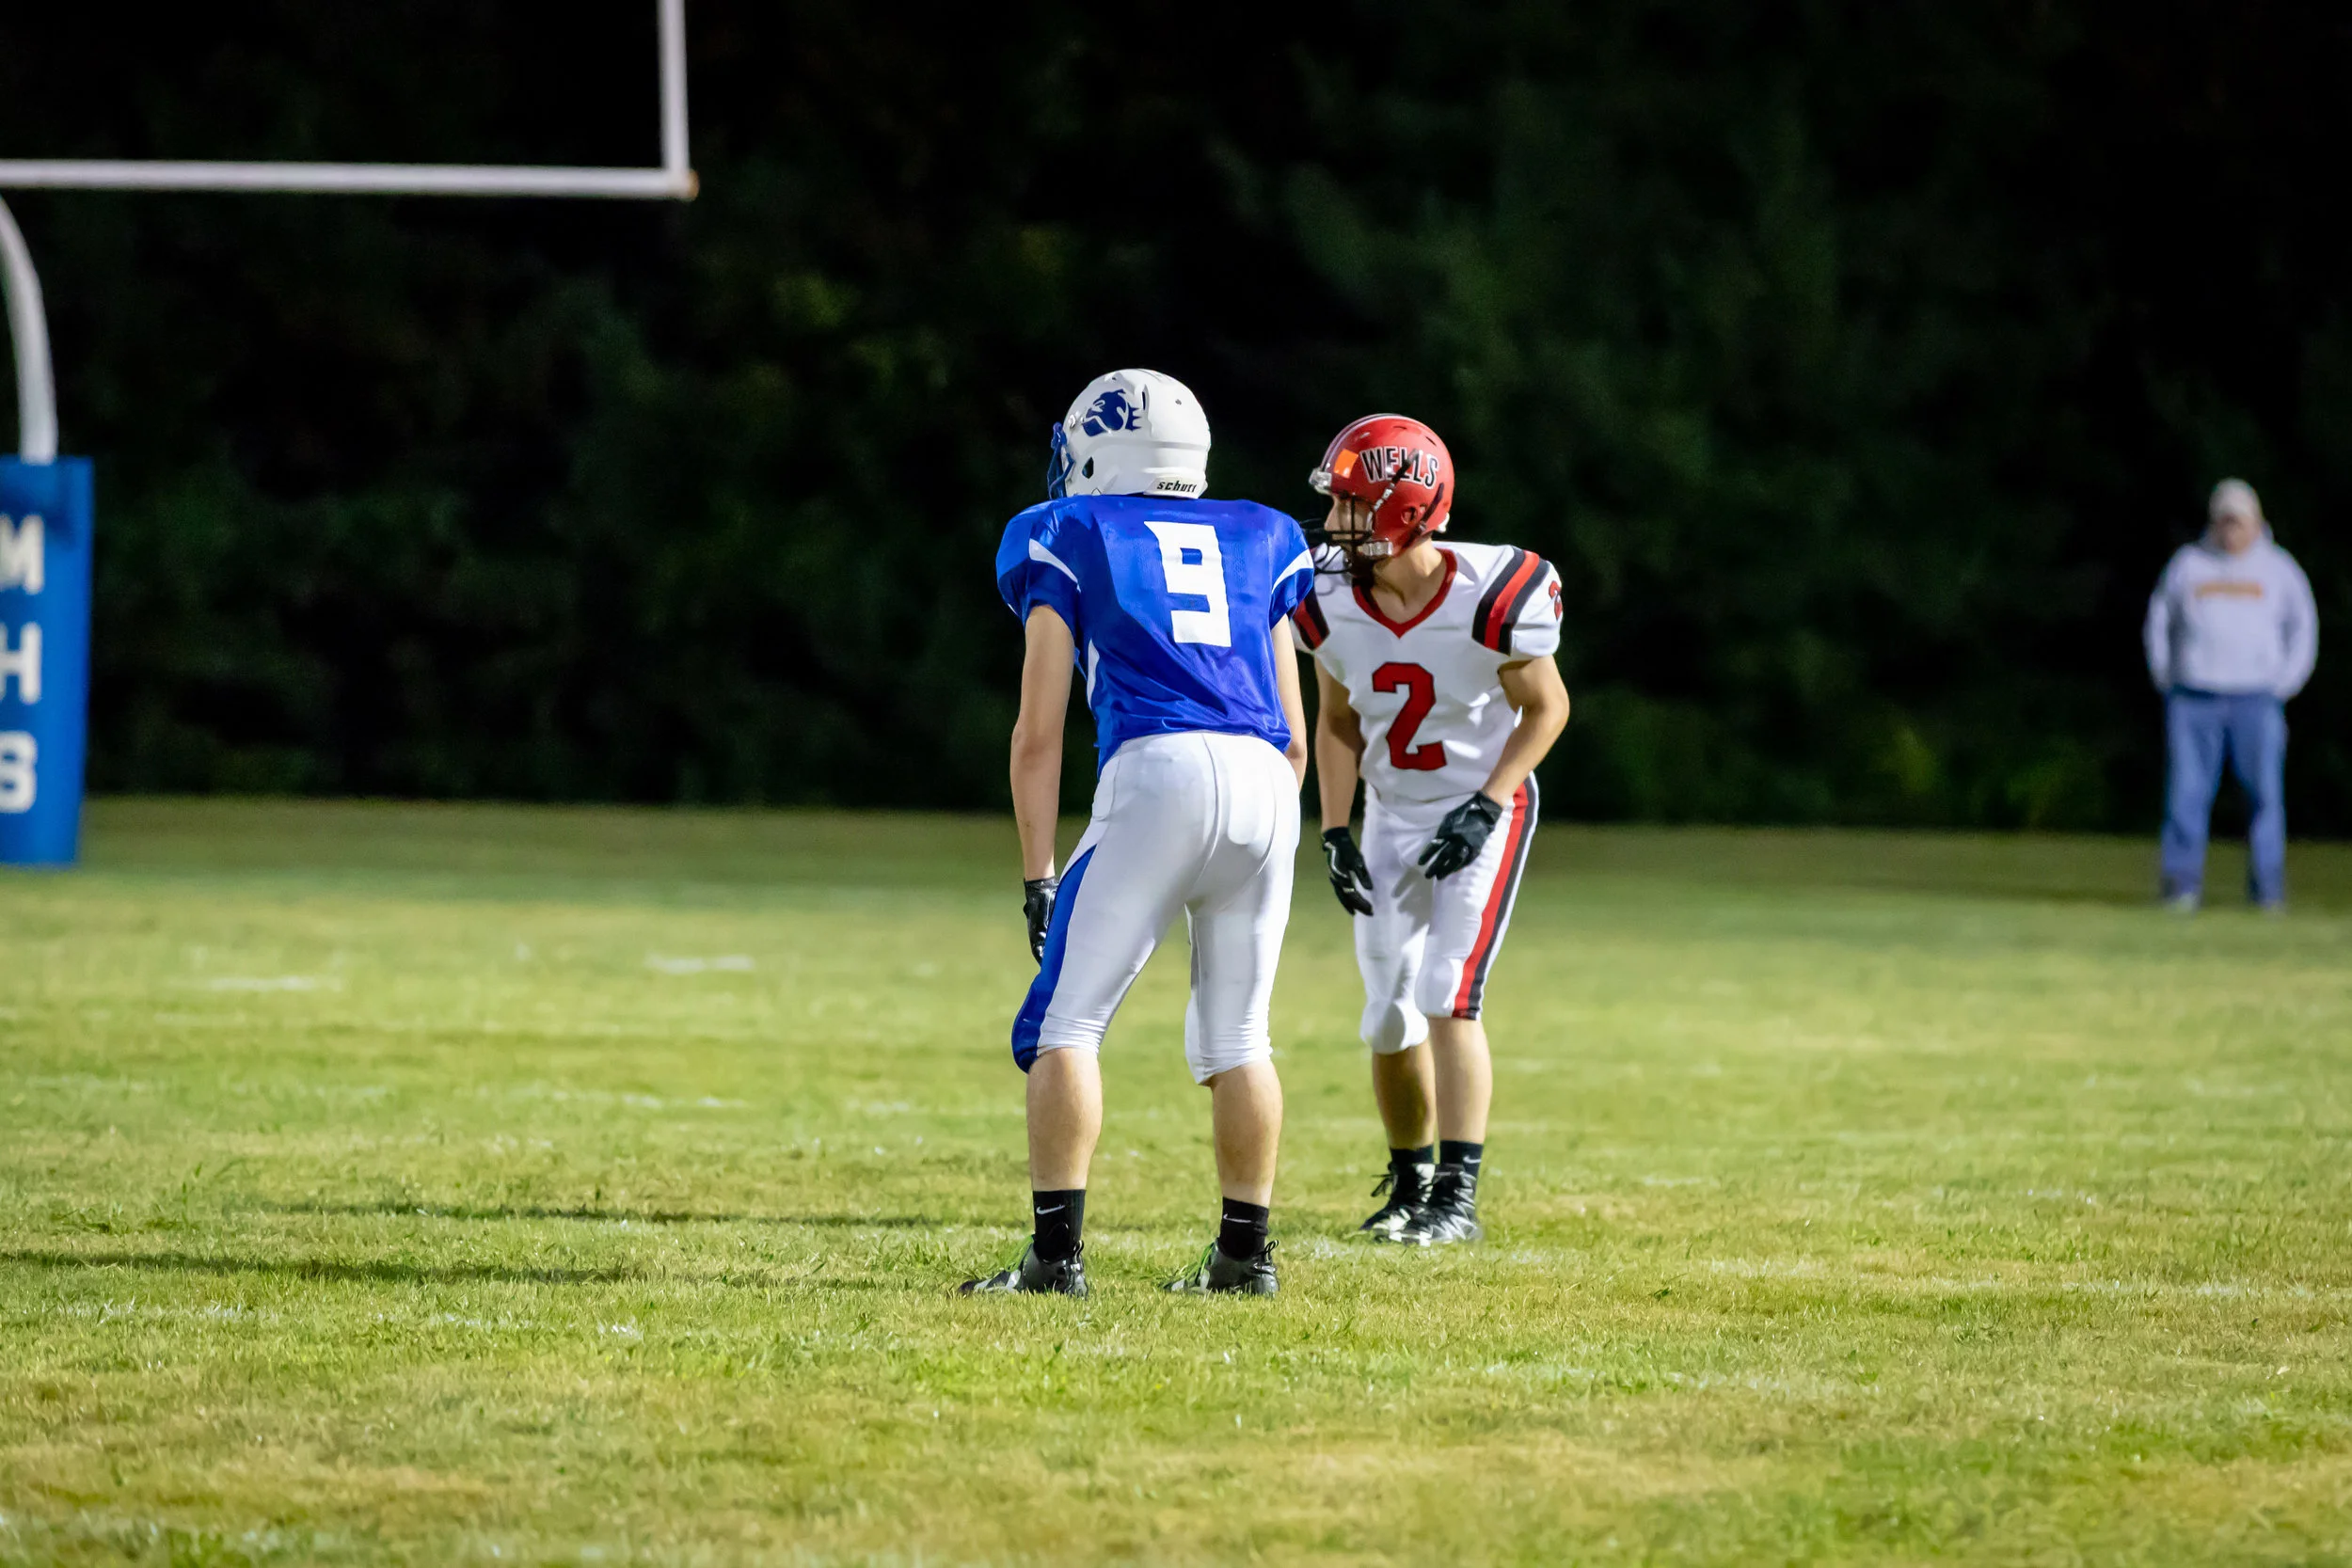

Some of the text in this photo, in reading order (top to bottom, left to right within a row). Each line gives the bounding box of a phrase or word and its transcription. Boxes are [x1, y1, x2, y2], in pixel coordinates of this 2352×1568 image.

[1359, 446, 1438, 489] WELLS
[1144, 520, 1232, 647] 9
[1372, 661, 1447, 770] 2
